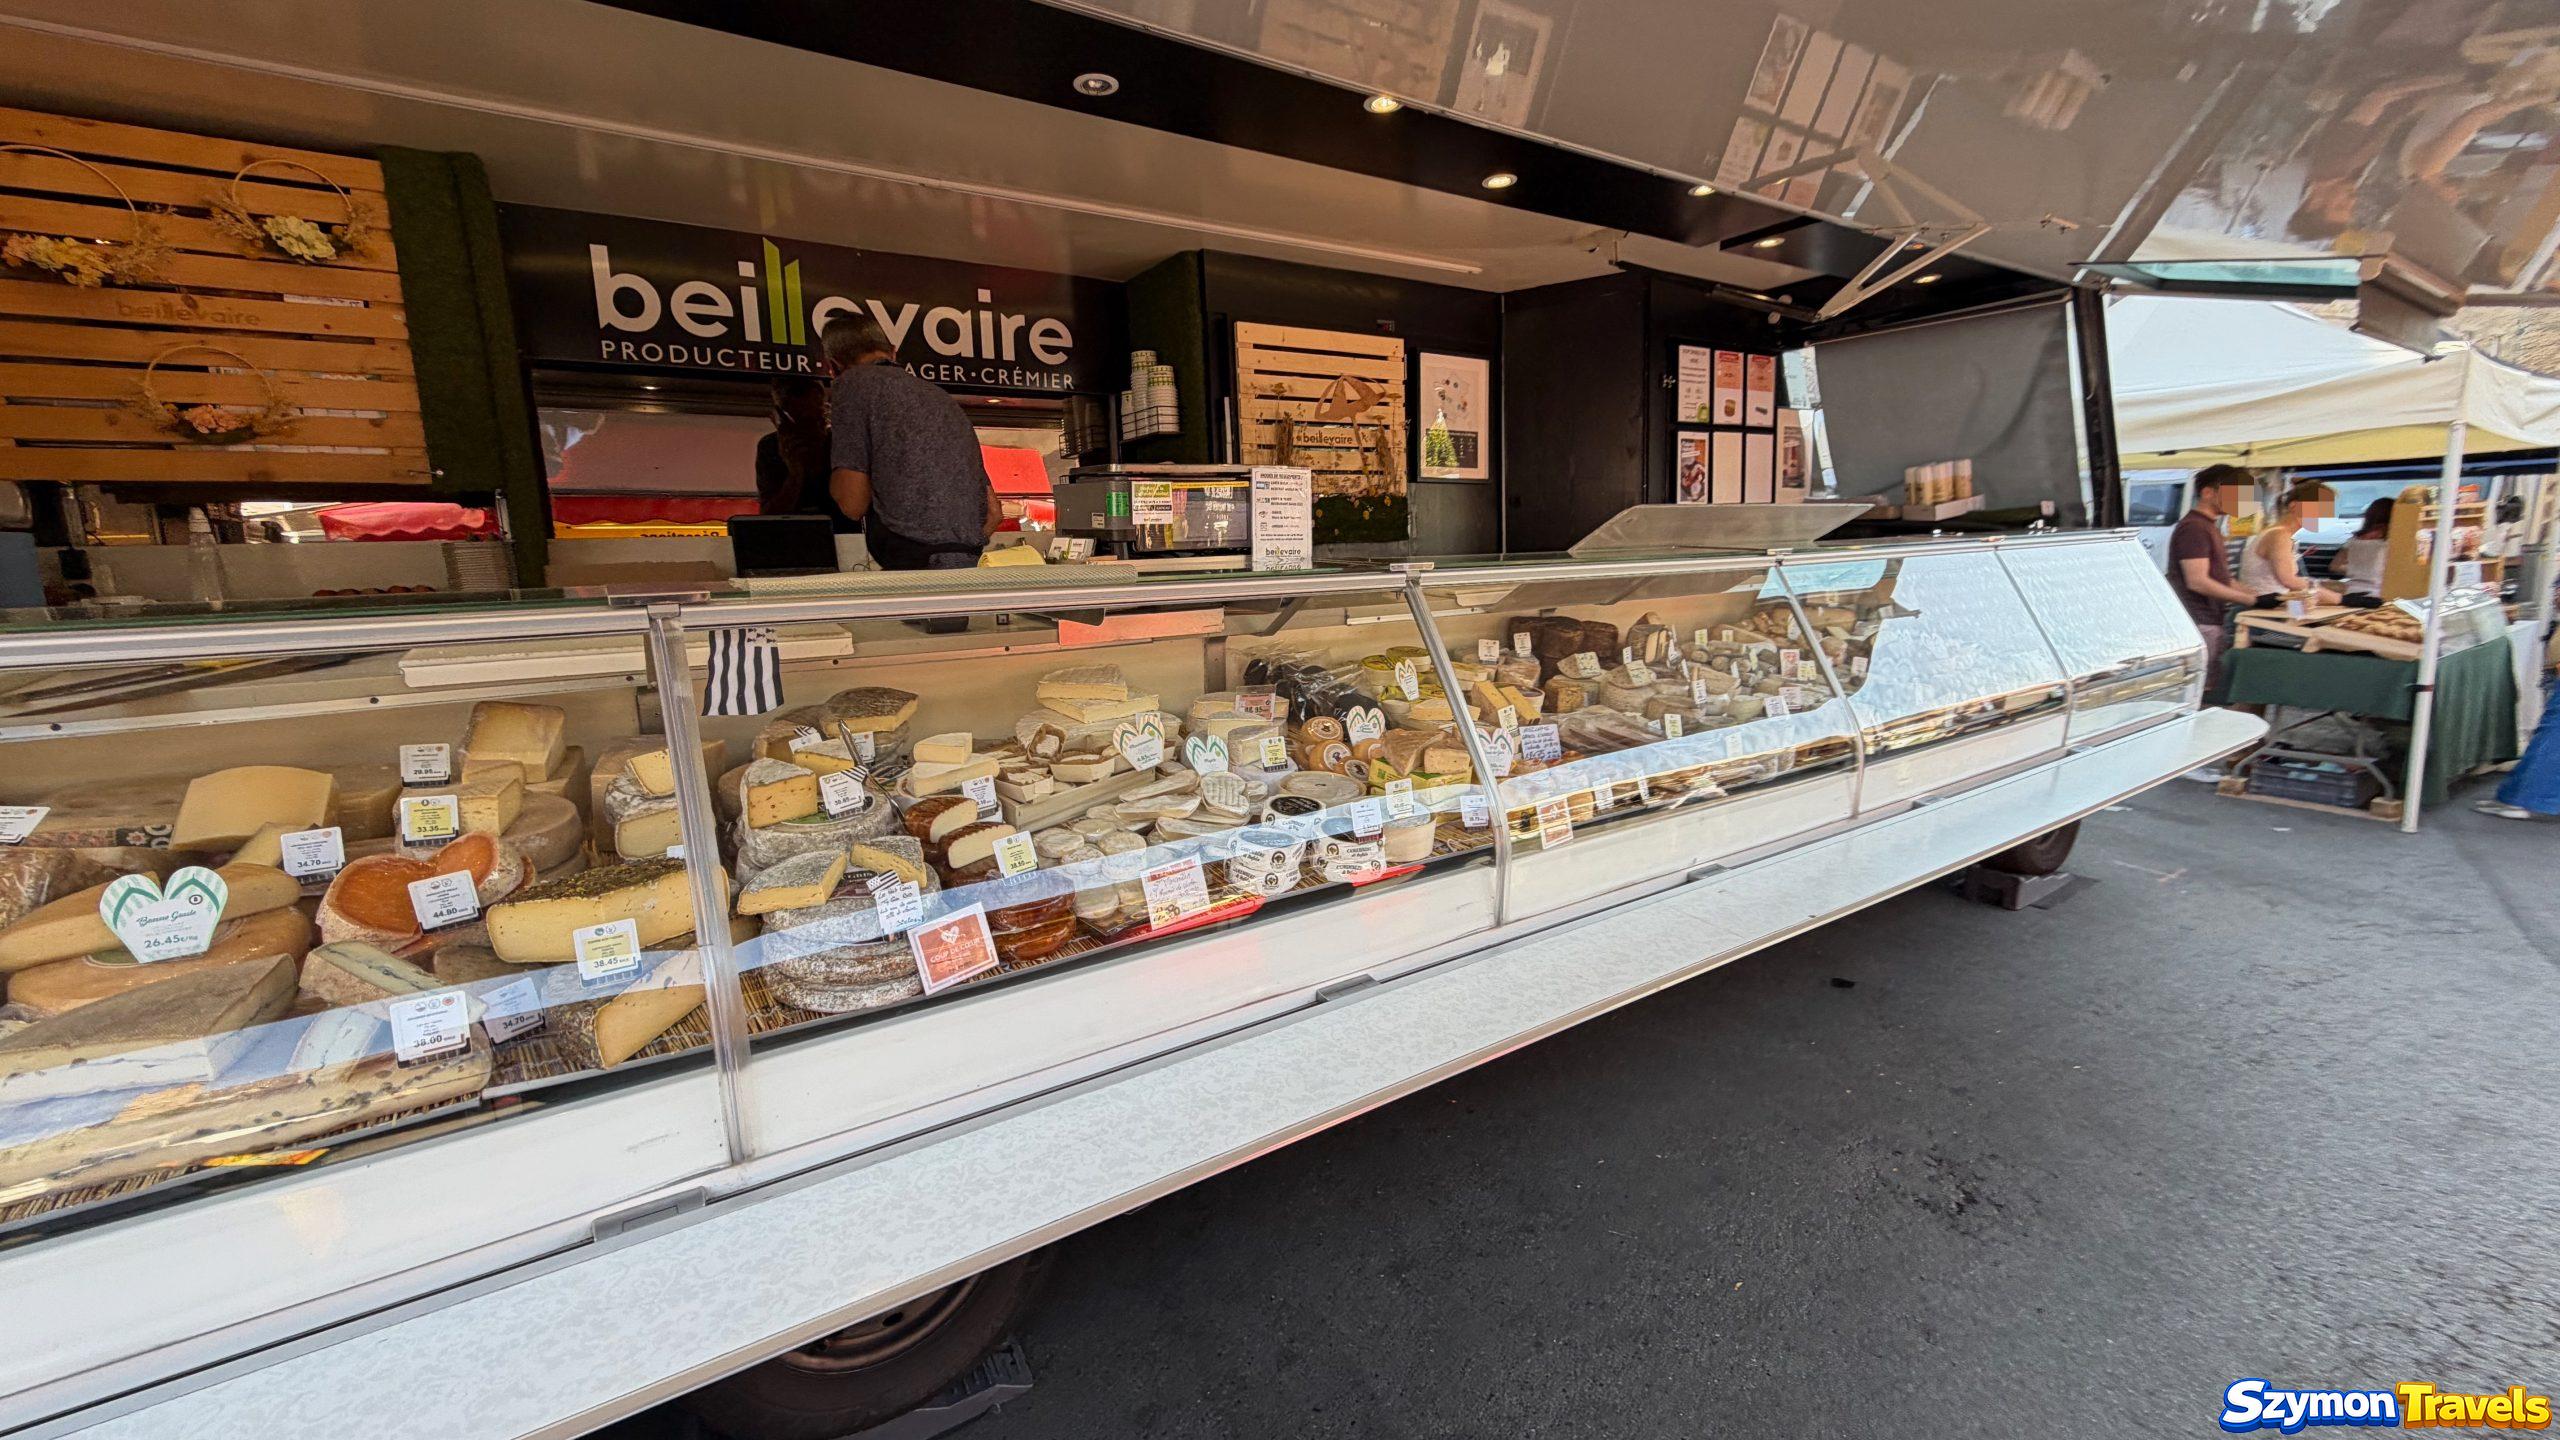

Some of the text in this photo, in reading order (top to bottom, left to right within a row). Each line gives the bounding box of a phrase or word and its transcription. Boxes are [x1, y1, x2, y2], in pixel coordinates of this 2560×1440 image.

[601, 339, 812, 373] PRODUCTEUR
[981, 366, 1075, 390] CRÉMIER
[297, 859, 321, 868] 34.70
[593, 957, 619, 968] 38.45
